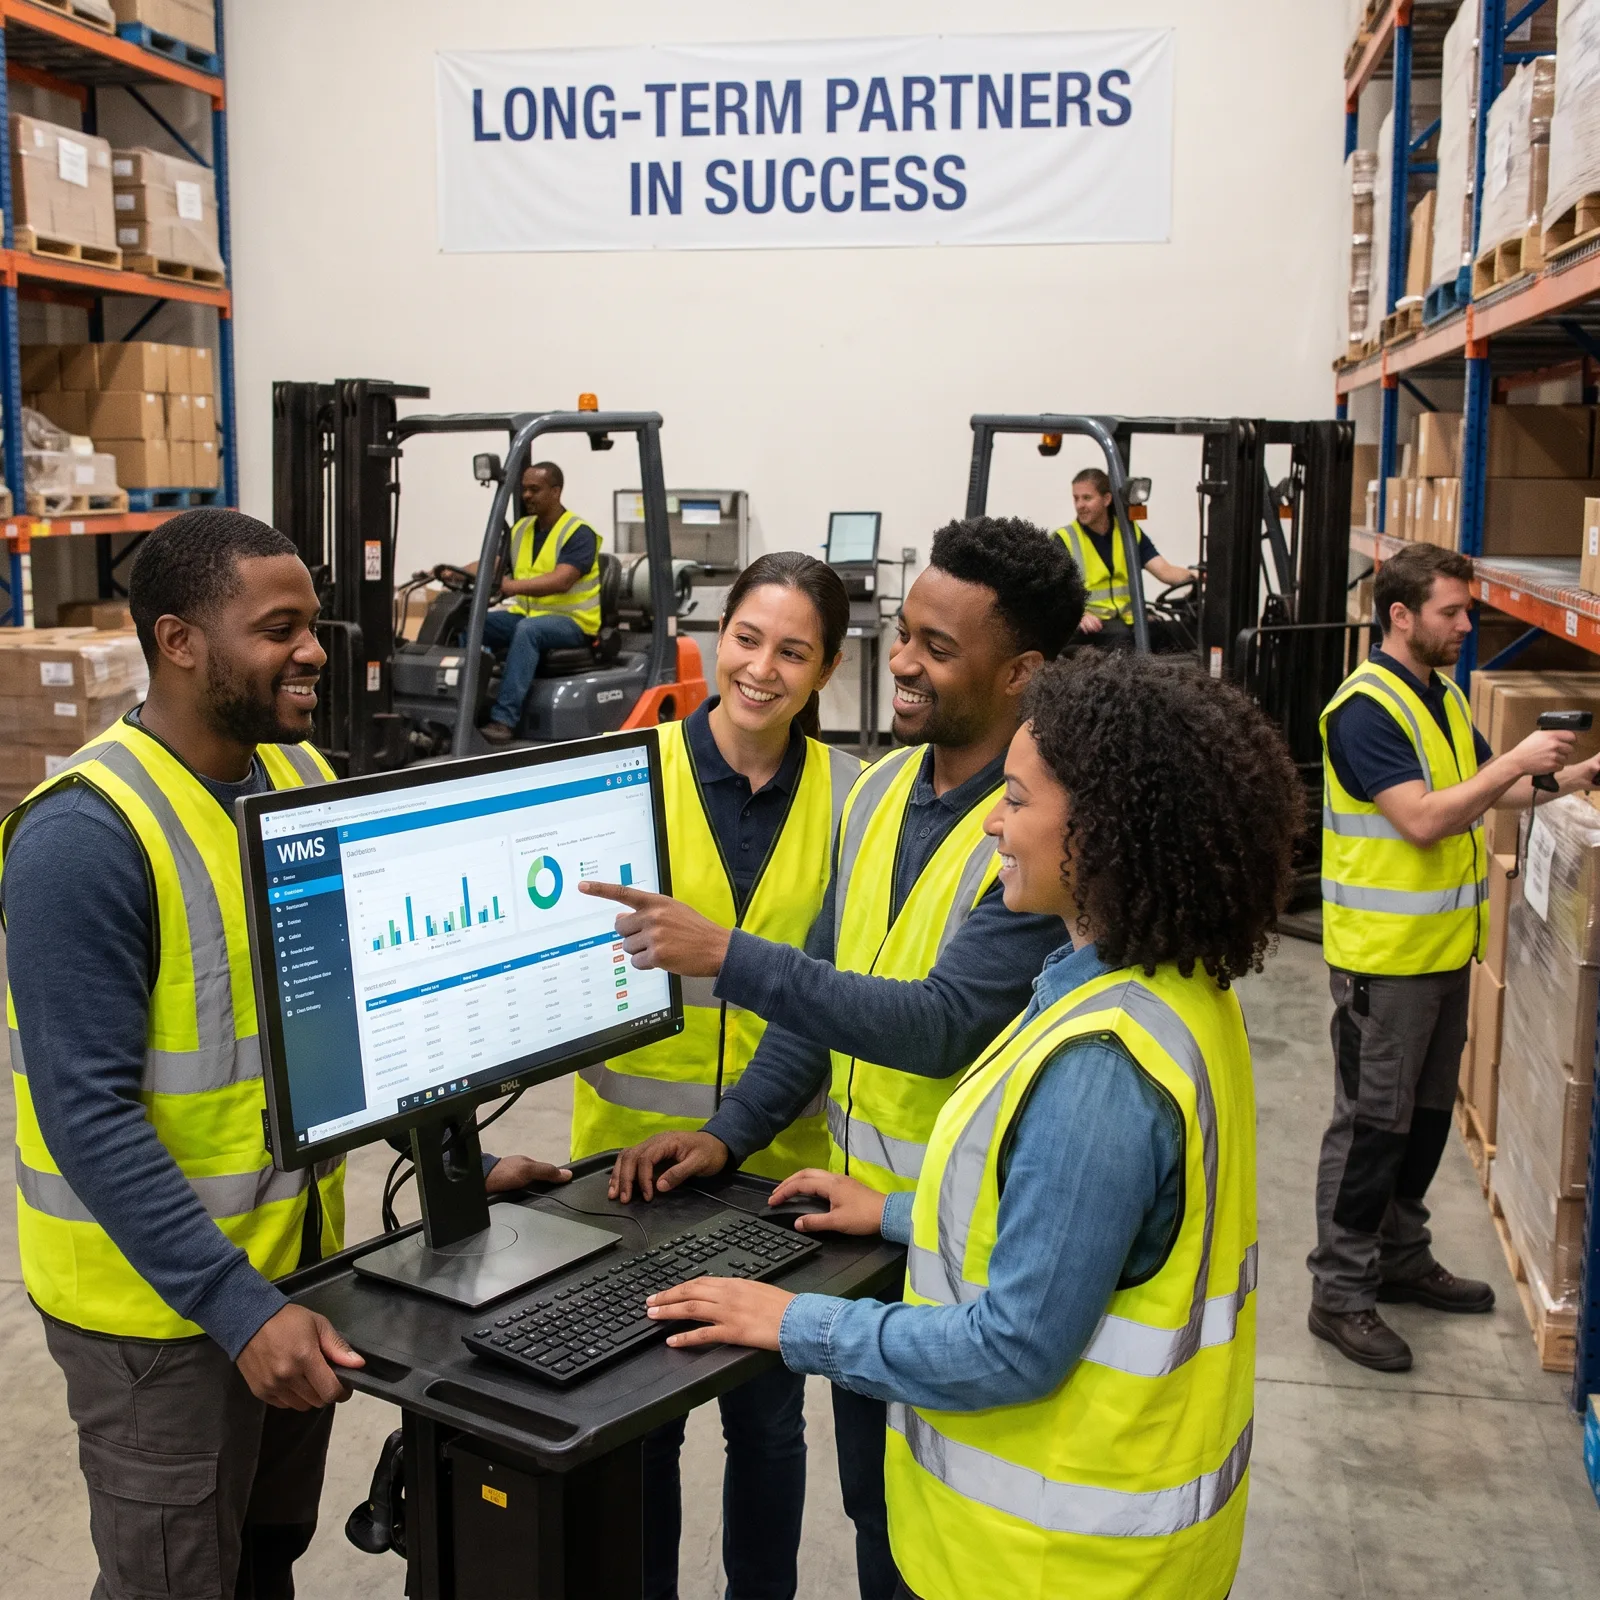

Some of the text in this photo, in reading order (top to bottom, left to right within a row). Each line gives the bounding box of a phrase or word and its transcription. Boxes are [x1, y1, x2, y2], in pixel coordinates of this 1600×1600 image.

[473, 68, 1133, 141] LONG-TERM PARTNERS
[631, 154, 967, 215] IN SUCCESS
[277, 836, 326, 864] WMS
